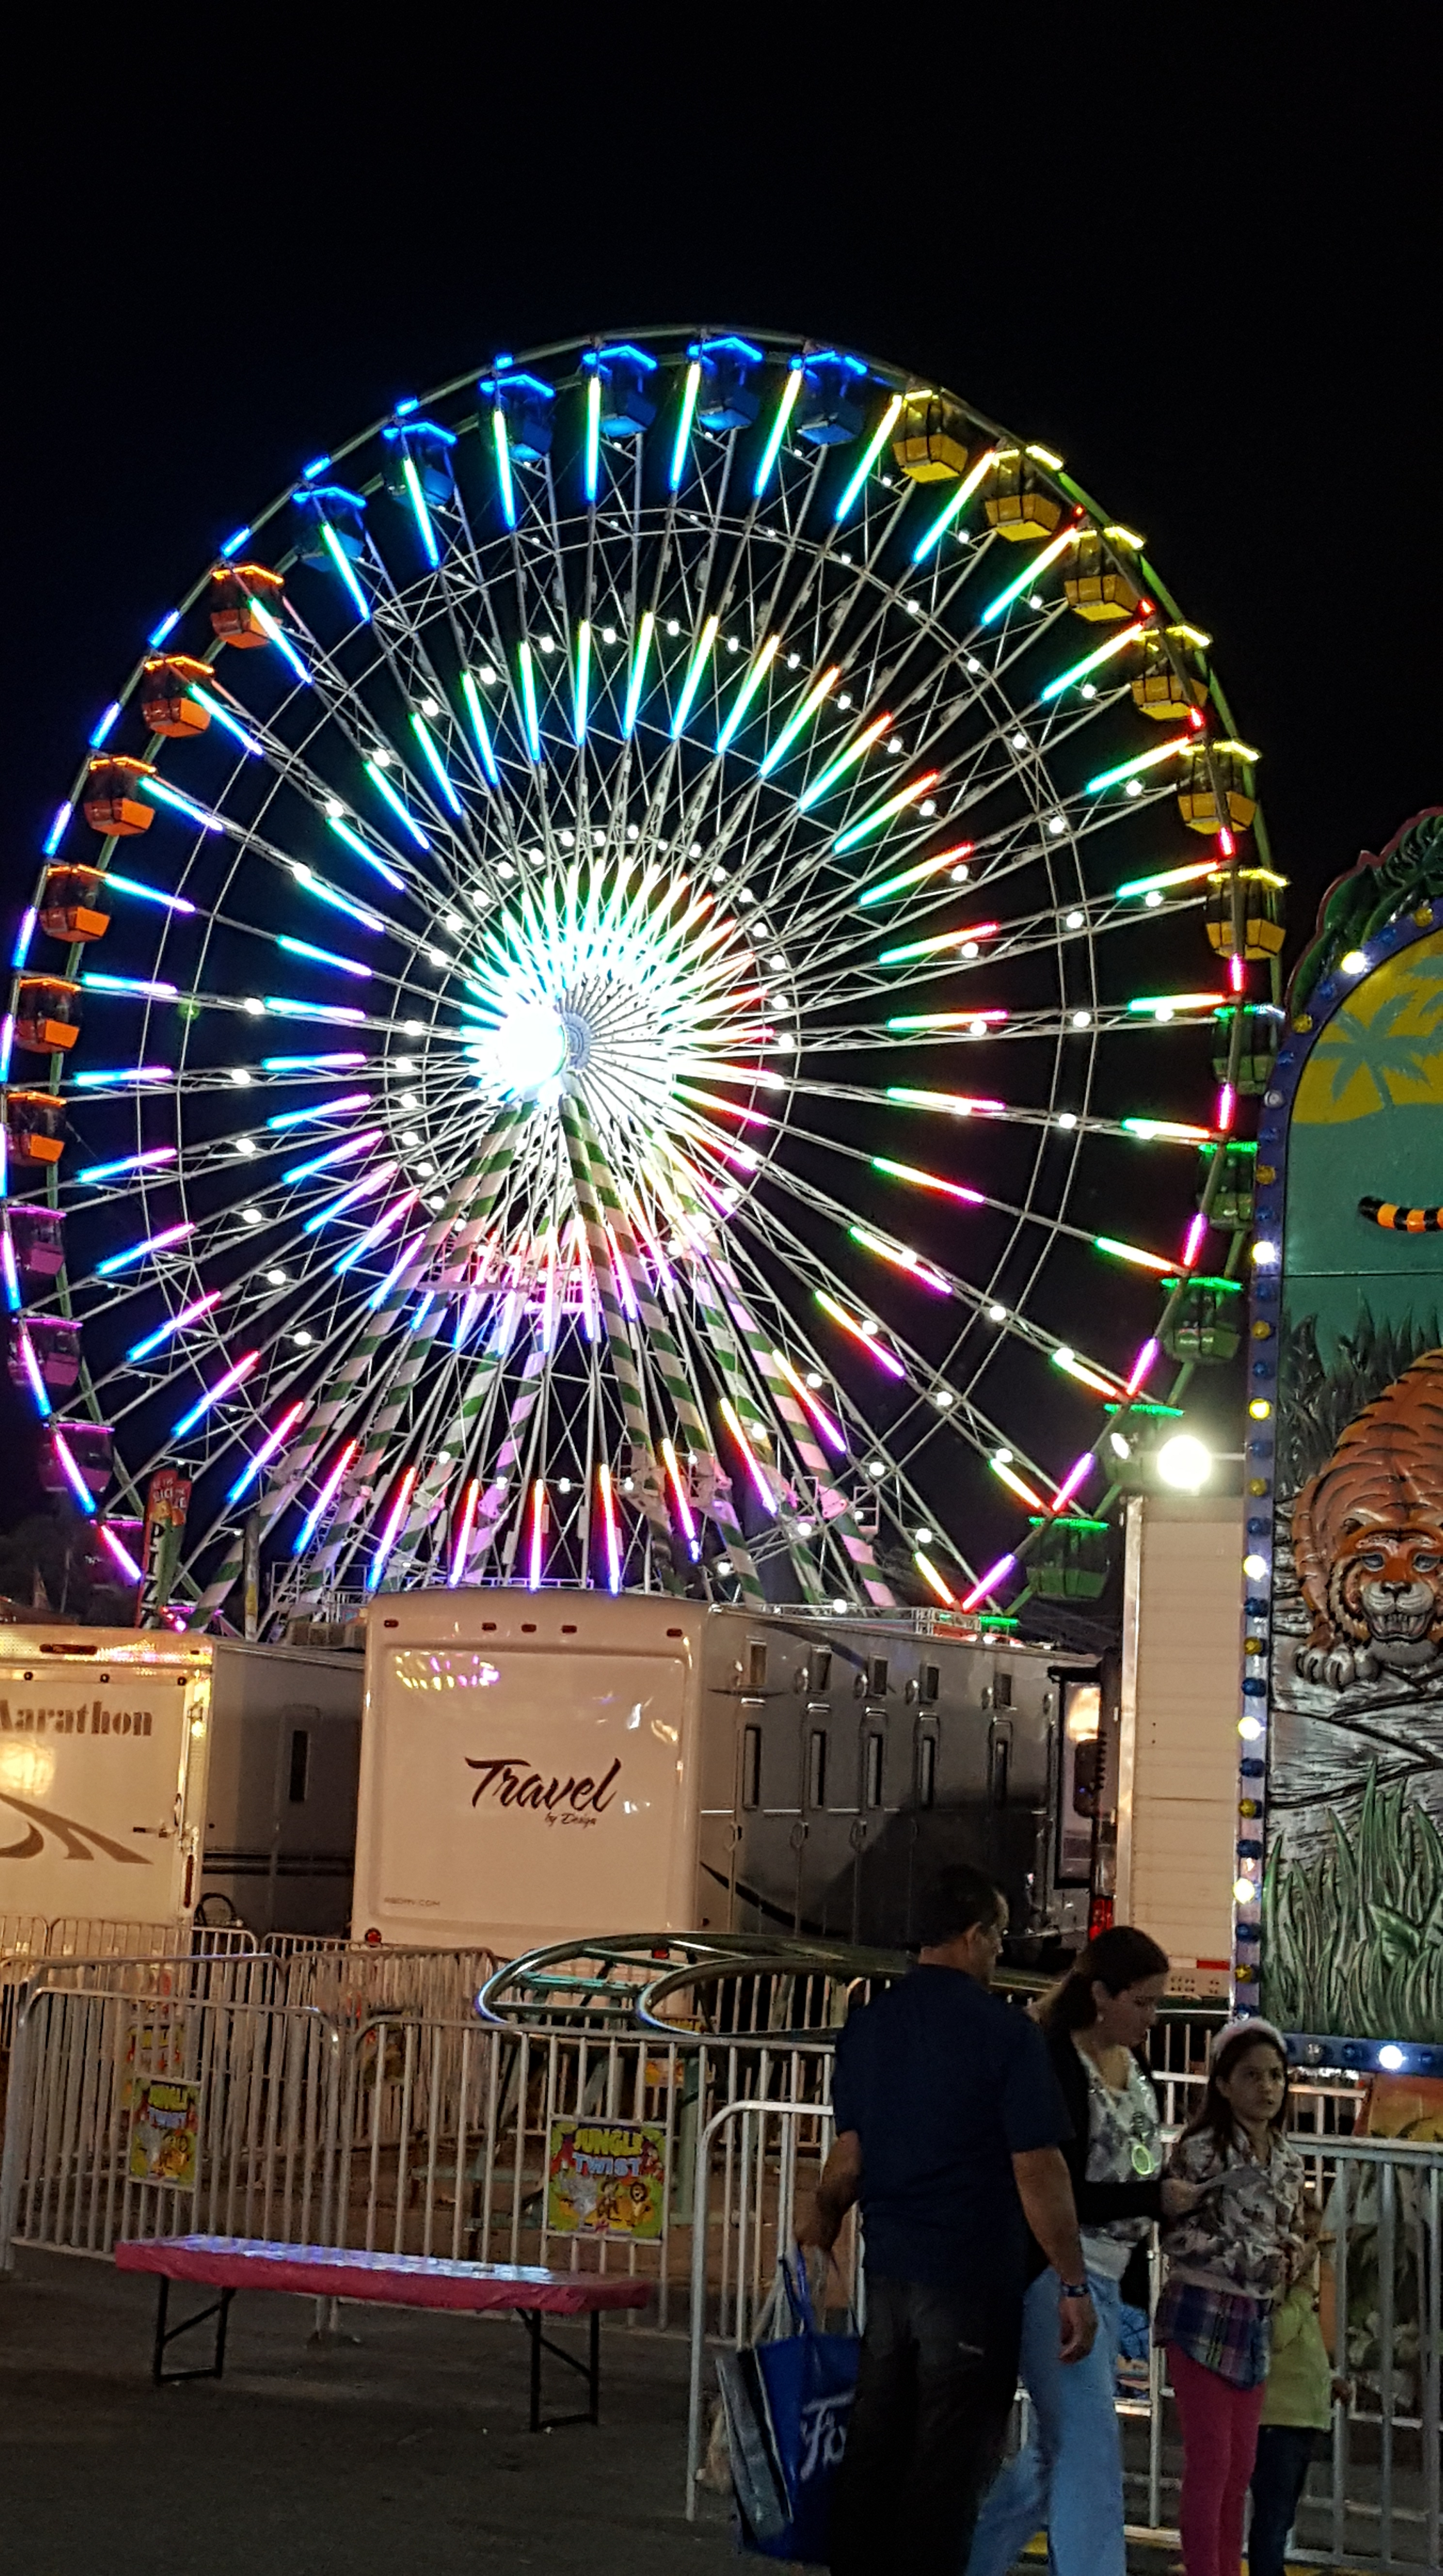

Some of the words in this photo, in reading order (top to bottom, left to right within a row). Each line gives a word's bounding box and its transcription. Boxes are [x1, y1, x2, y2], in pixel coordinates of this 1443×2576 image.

[465, 1757, 621, 1812] Travel
[545, 1812, 558, 1827] by
[573, 2127, 642, 2157] JUNGLE
[572, 2152, 642, 2177] TWIST
